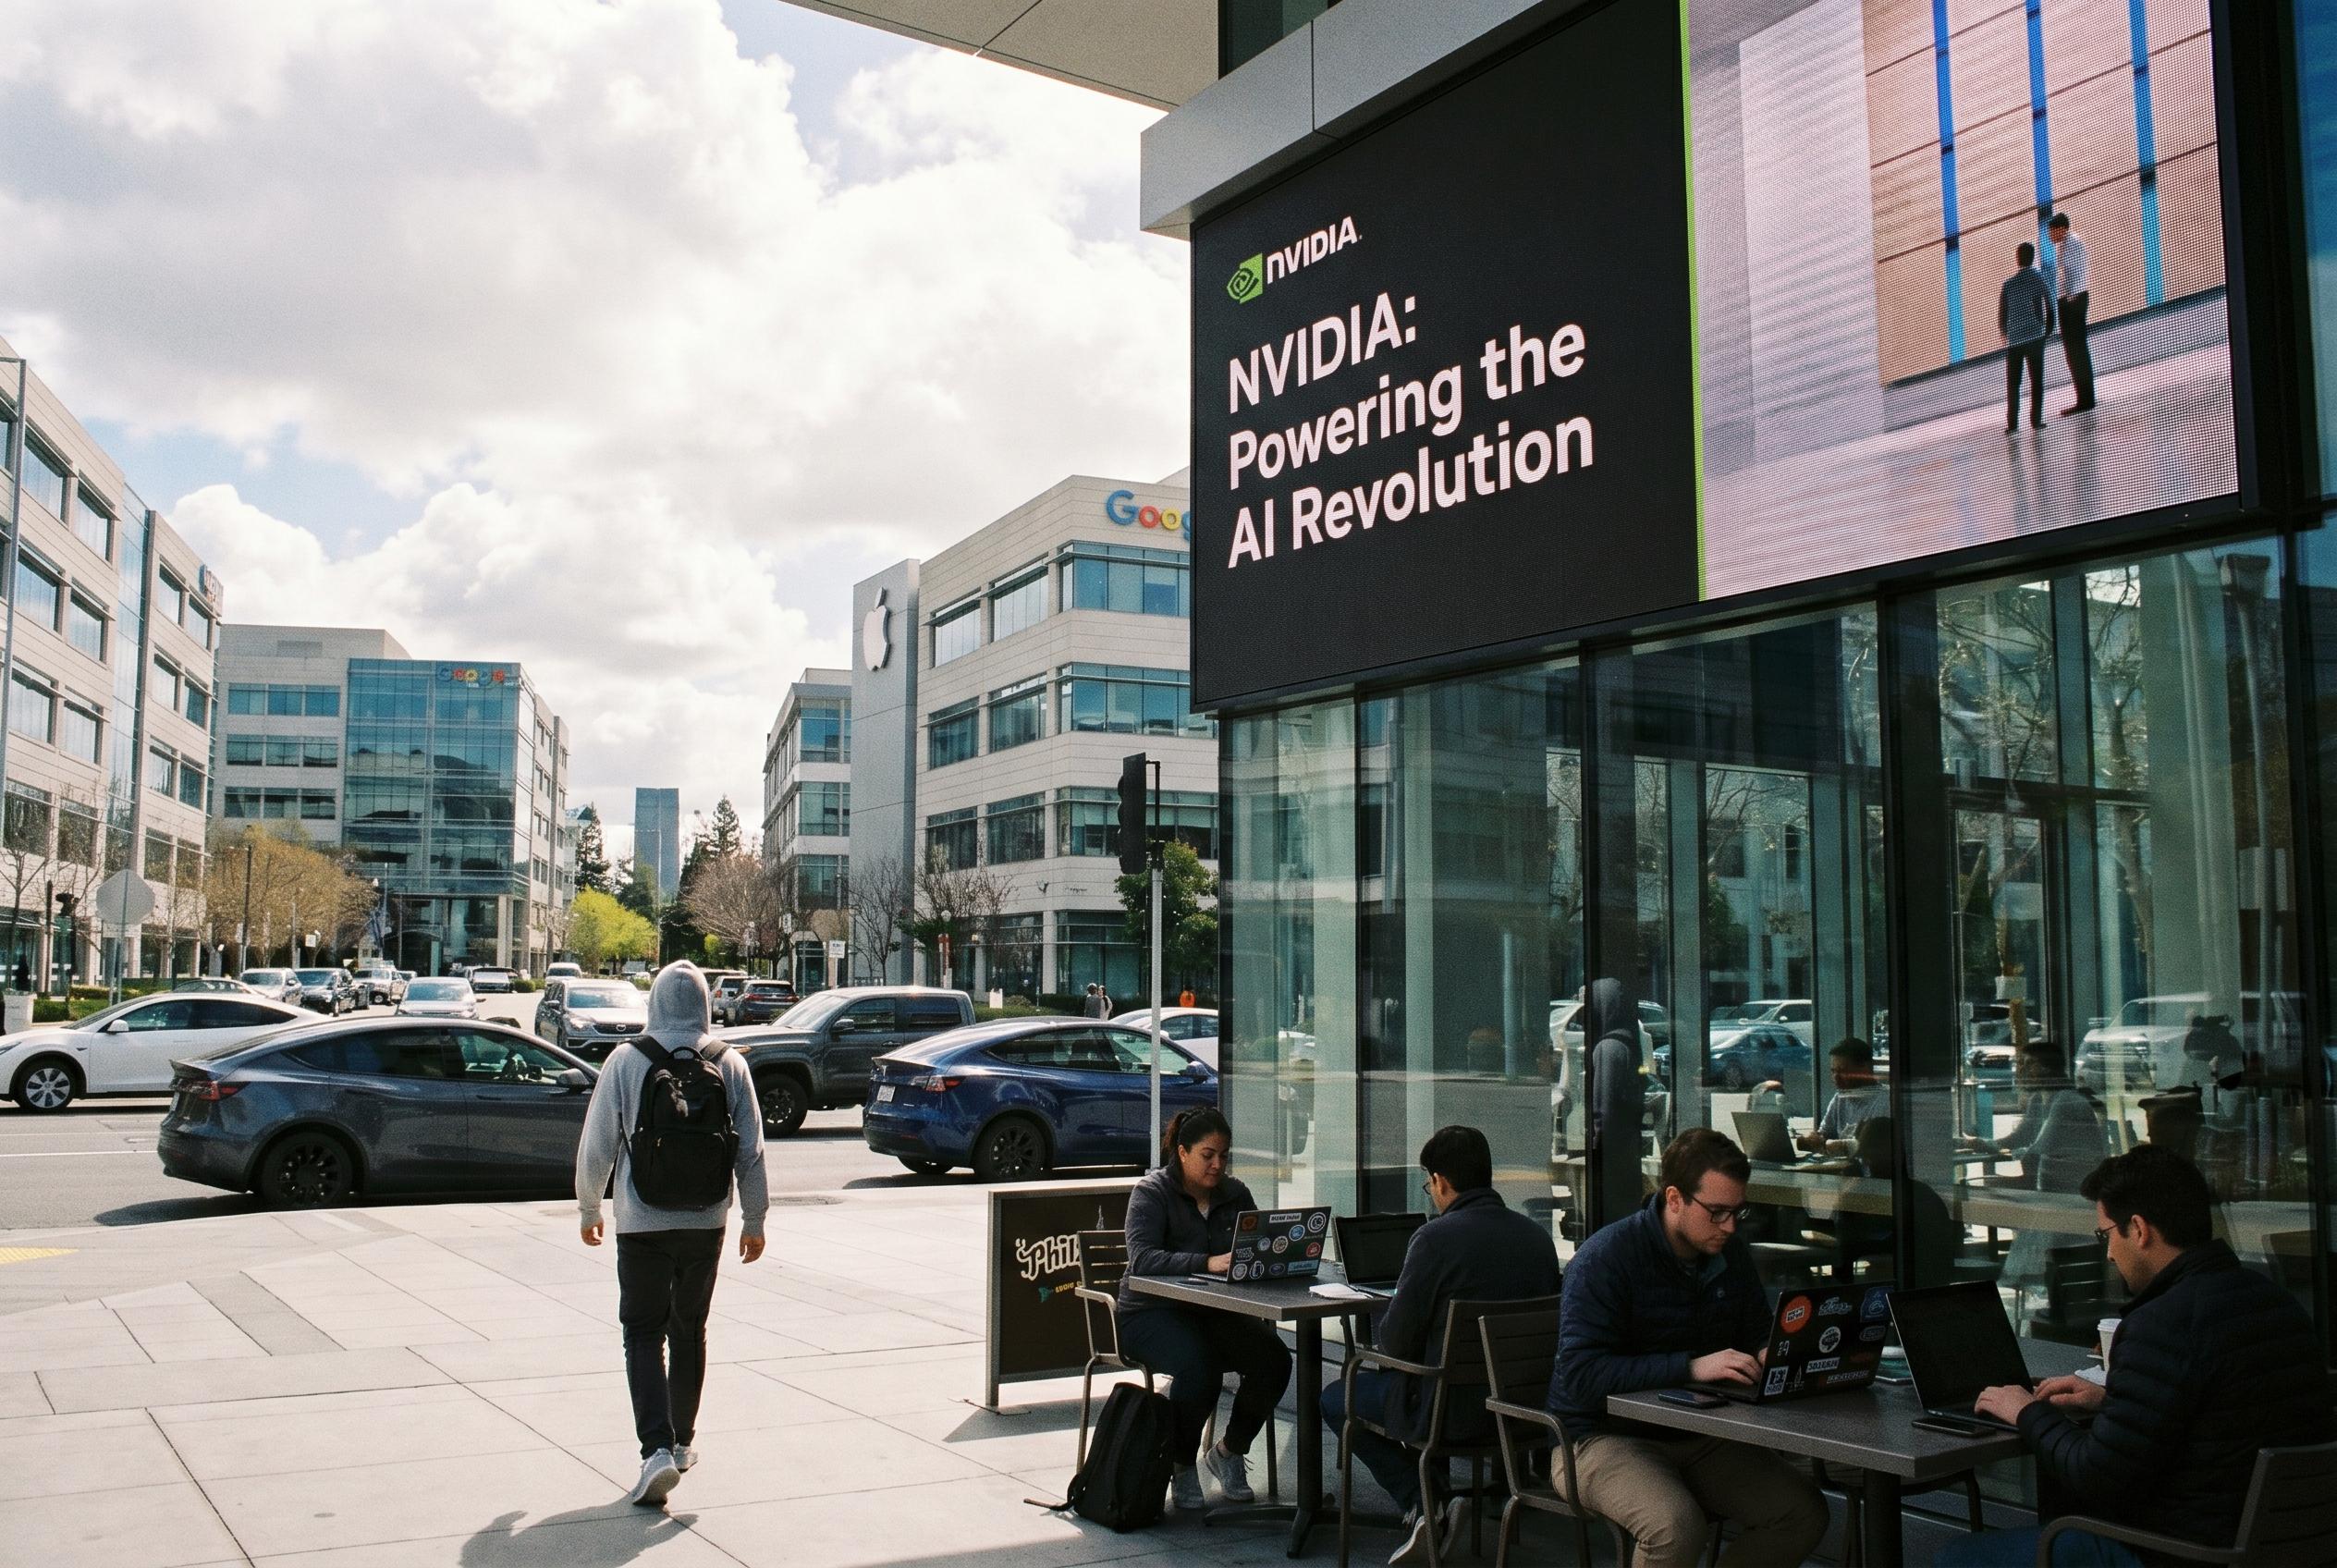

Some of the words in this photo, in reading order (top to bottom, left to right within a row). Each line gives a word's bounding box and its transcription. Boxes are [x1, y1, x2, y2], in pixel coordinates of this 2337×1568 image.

[1229, 292, 1417, 414] NVIDIA:
[1230, 364, 1463, 491] Powering
[1479, 324, 1586, 400] the
[1228, 498, 1275, 570] AI
[1291, 416, 1595, 552] Revolution
